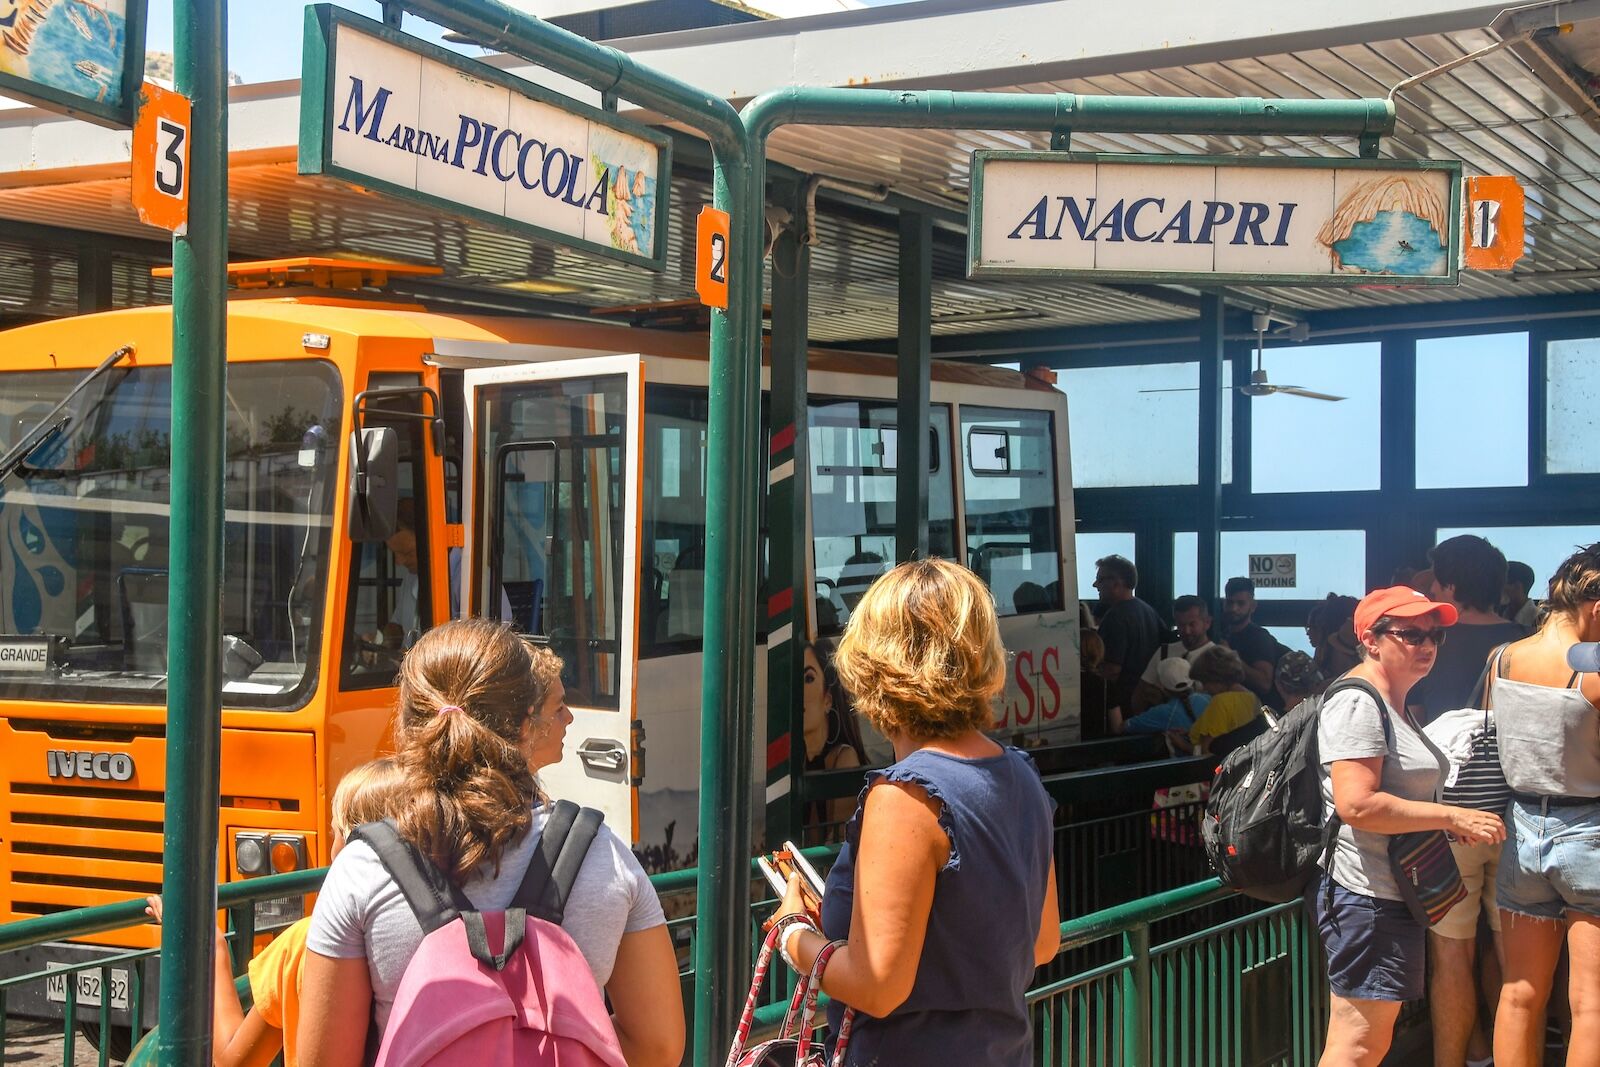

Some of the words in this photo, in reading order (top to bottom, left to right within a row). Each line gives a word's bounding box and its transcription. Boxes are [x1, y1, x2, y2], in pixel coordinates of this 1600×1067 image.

[157, 121, 184, 195] 3
[450, 114, 609, 215] PICCOLA
[1009, 195, 1298, 246] ANACAPRI
[1478, 201, 1490, 248] 1
[711, 233, 725, 284] 2
[1250, 557, 1273, 572] NO
[0, 648, 46, 661] GRANDE
[47, 750, 132, 781] IVECO
[48, 974, 65, 994] NA
